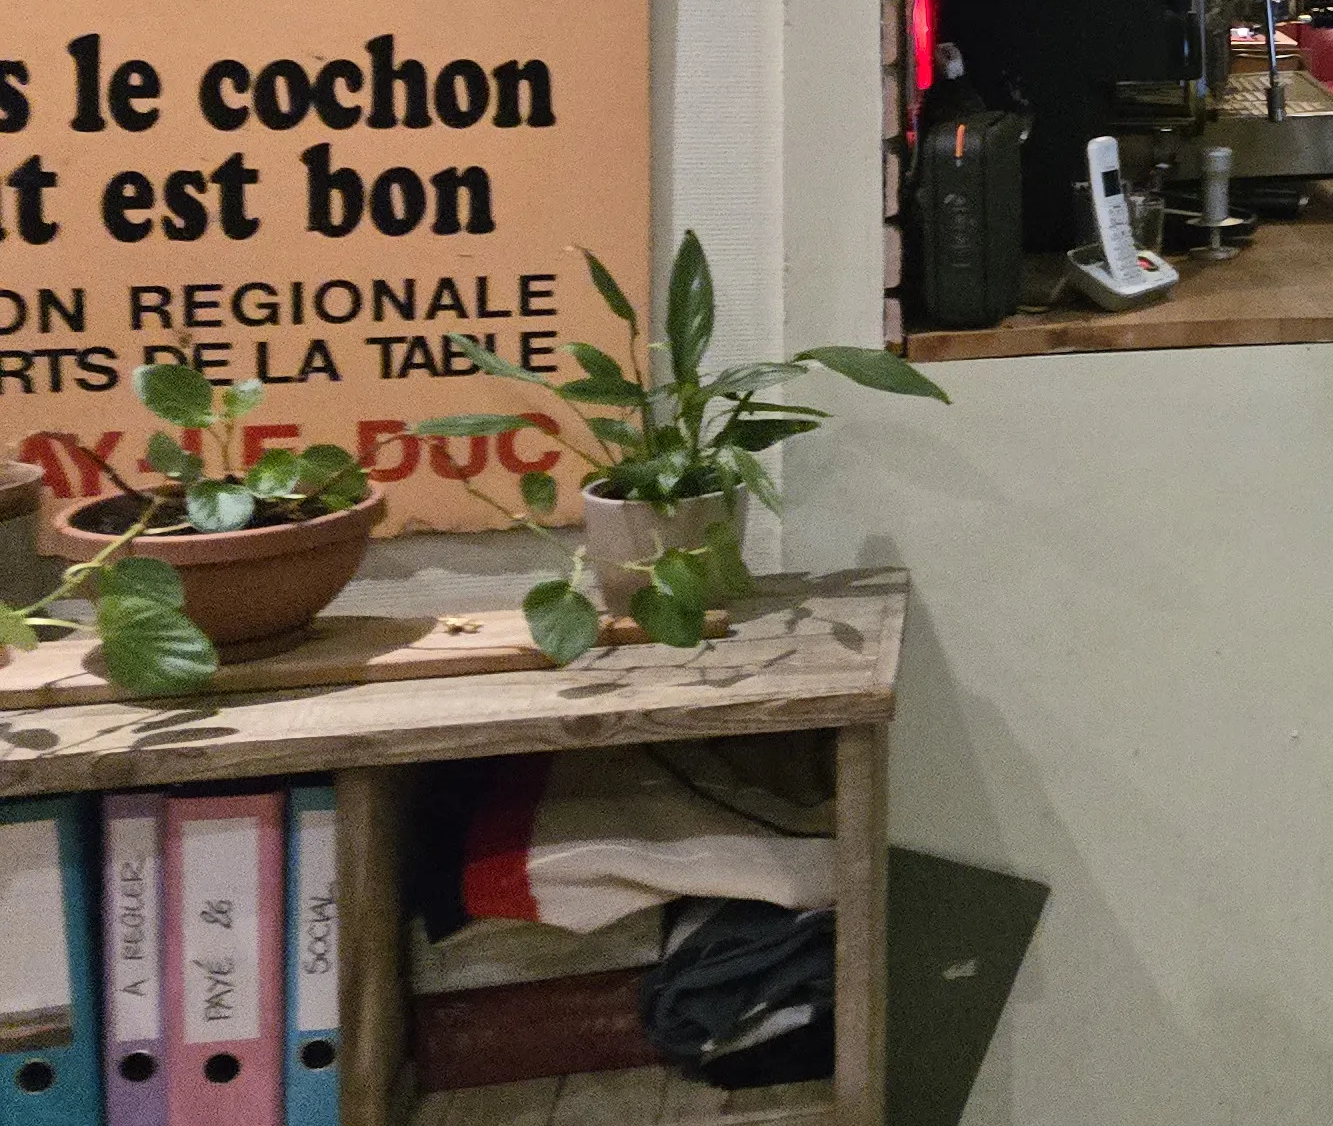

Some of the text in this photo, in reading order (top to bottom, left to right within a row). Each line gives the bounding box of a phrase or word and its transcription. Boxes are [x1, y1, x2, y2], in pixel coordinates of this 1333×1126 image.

[66, 32, 162, 132] le
[199, 34, 556, 131] cochon
[102, 152, 261, 243] est
[300, 142, 496, 238] bon
[128, 274, 558, 330] REGIONALE
[256, 338, 342, 385] LA
[357, 413, 561, 483] DUC
